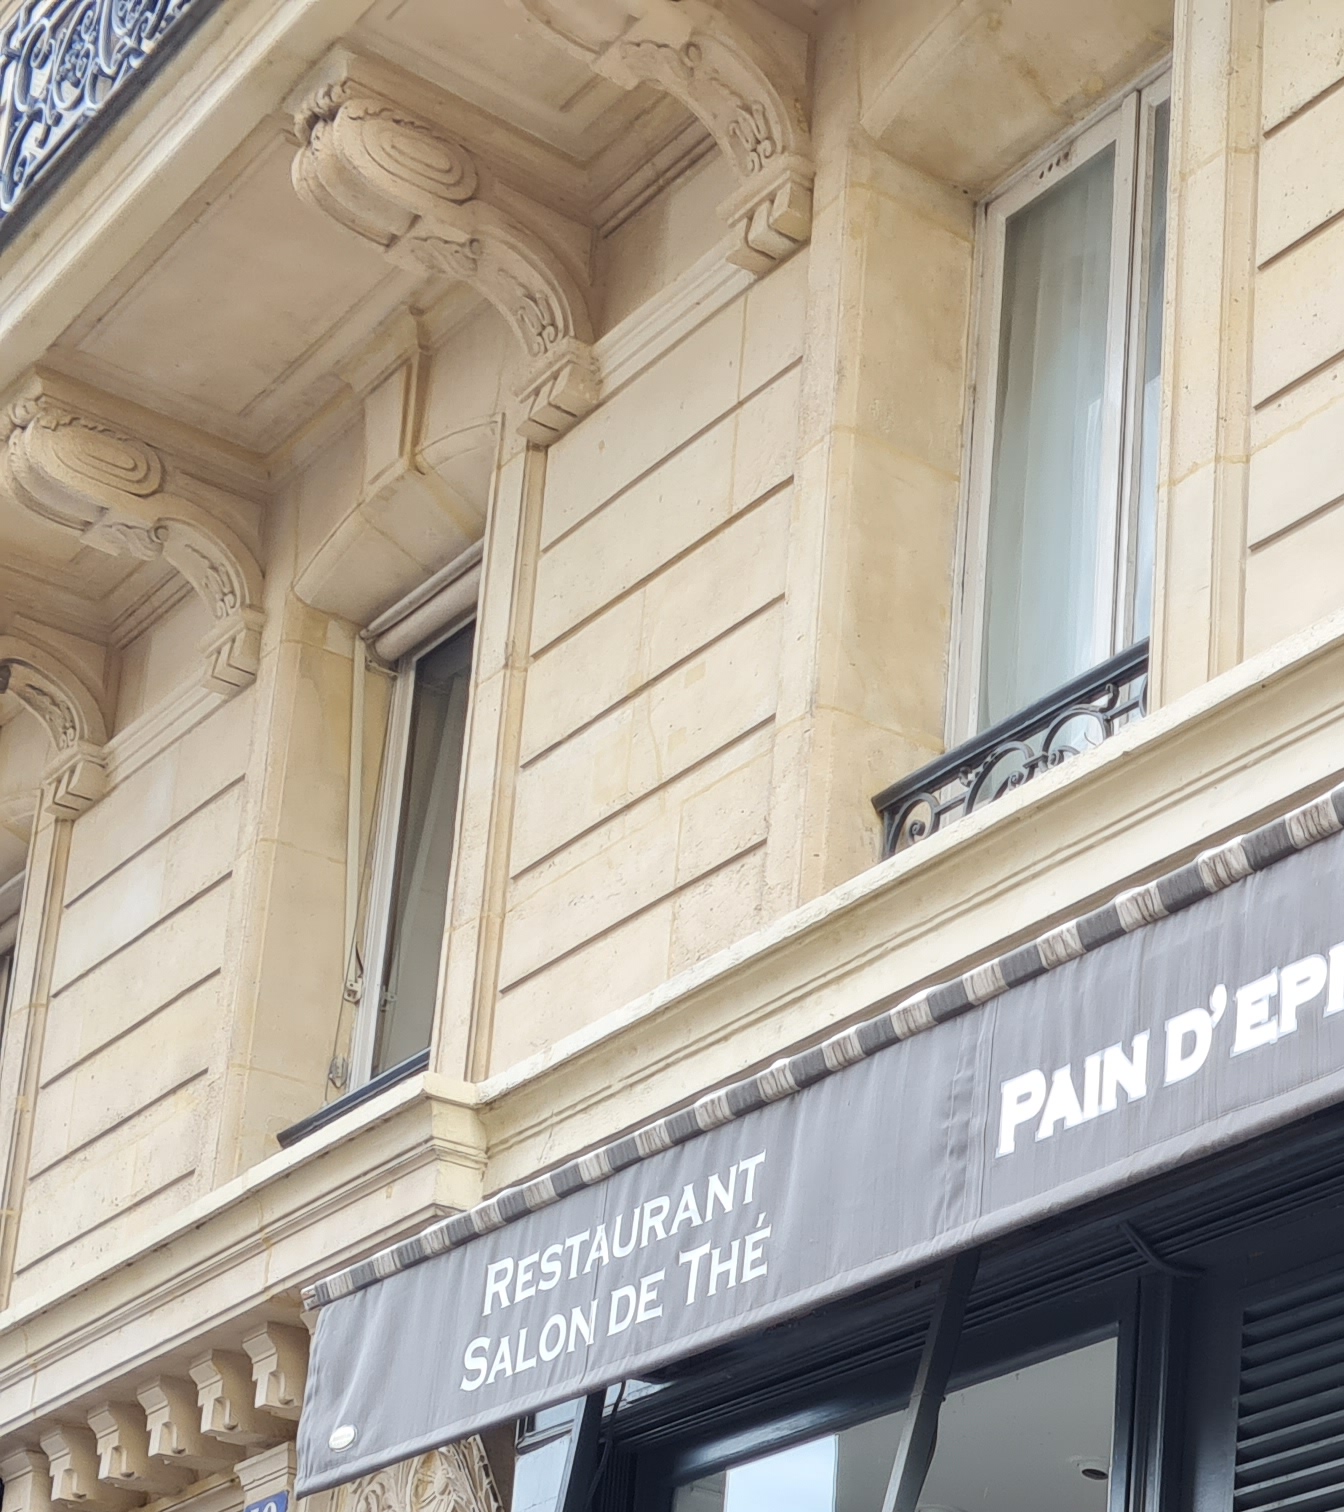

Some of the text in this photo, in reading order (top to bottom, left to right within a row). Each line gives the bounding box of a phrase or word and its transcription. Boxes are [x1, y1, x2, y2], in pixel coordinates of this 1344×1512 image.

[995, 1033, 1149, 1160] PAIN
[460, 1214, 773, 1393] SALON DE THÉ
[484, 1149, 768, 1316] RESTAURANT
